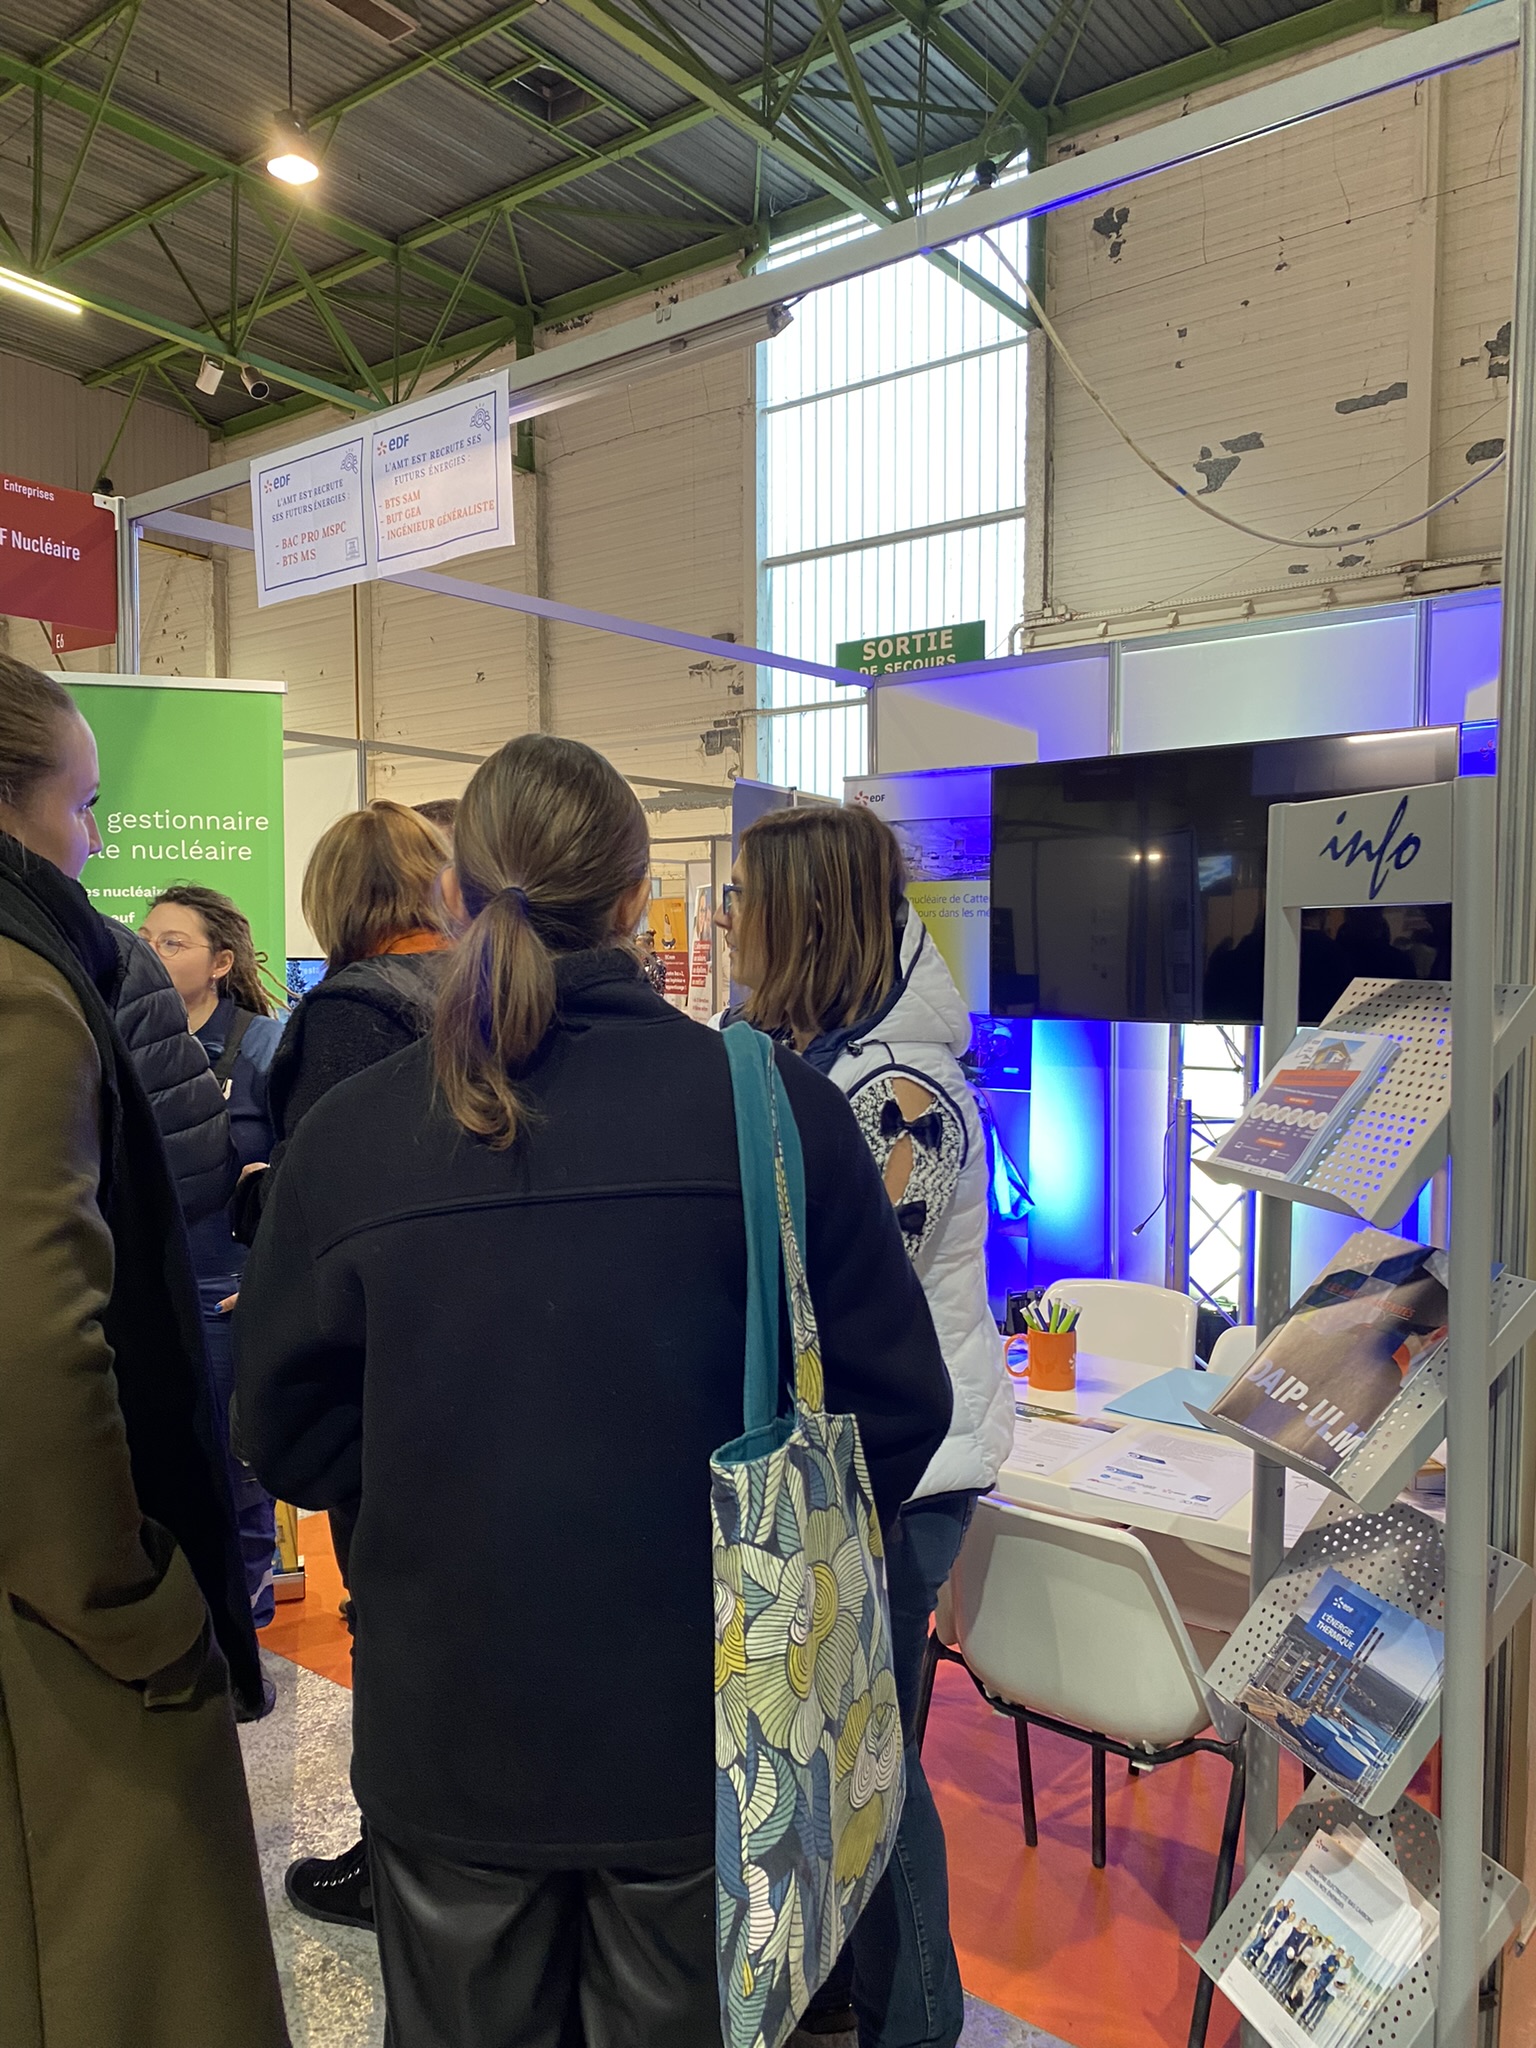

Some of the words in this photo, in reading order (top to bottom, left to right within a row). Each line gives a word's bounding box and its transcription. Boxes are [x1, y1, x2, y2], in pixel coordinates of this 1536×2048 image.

[385, 458, 408, 473] L'AMT
[412, 453, 427, 465] EST
[431, 440, 464, 460] RECRUTE
[467, 434, 481, 445] SES
[394, 468, 425, 485] FUTURS
[429, 455, 465, 476] ÉNERGIES
[4, 479, 54, 501] Entreprises
[277, 494, 296, 507] L'AMT
[299, 490, 312, 500] EST
[314, 479, 343, 496] RECRUTE
[385, 496, 400, 509] BTS
[403, 490, 421, 504] SAM
[272, 512, 283, 522] SES
[285, 504, 312, 519] FUTURS
[387, 512, 403, 525] BUT
[405, 507, 421, 520] GEA
[387, 519, 434, 540] INGÉNIEUR
[438, 500, 495, 526] GÉNÉRALISTE
[12, 530, 80, 560] Nucléaire
[282, 535, 298, 549] BAC
[302, 530, 319, 544] PRO
[322, 521, 346, 538] MSPC
[283, 552, 298, 566] BTS
[302, 549, 316, 561] MS
[56, 634, 64, 648] E6
[863, 629, 952, 661] SORTIE
[884, 654, 956, 673] SECOURS
[107, 809, 269, 833] gestionnaire
[132, 840, 252, 861] nucléaire
[1319, 795, 1421, 900] info
[950, 895, 960, 903] de
[939, 908, 959, 917] dans
[962, 908, 974, 917] les
[1316, 1620, 1355, 1650] THERMIQUE
[1321, 1613, 1355, 1638] L'ÉNERGIE
